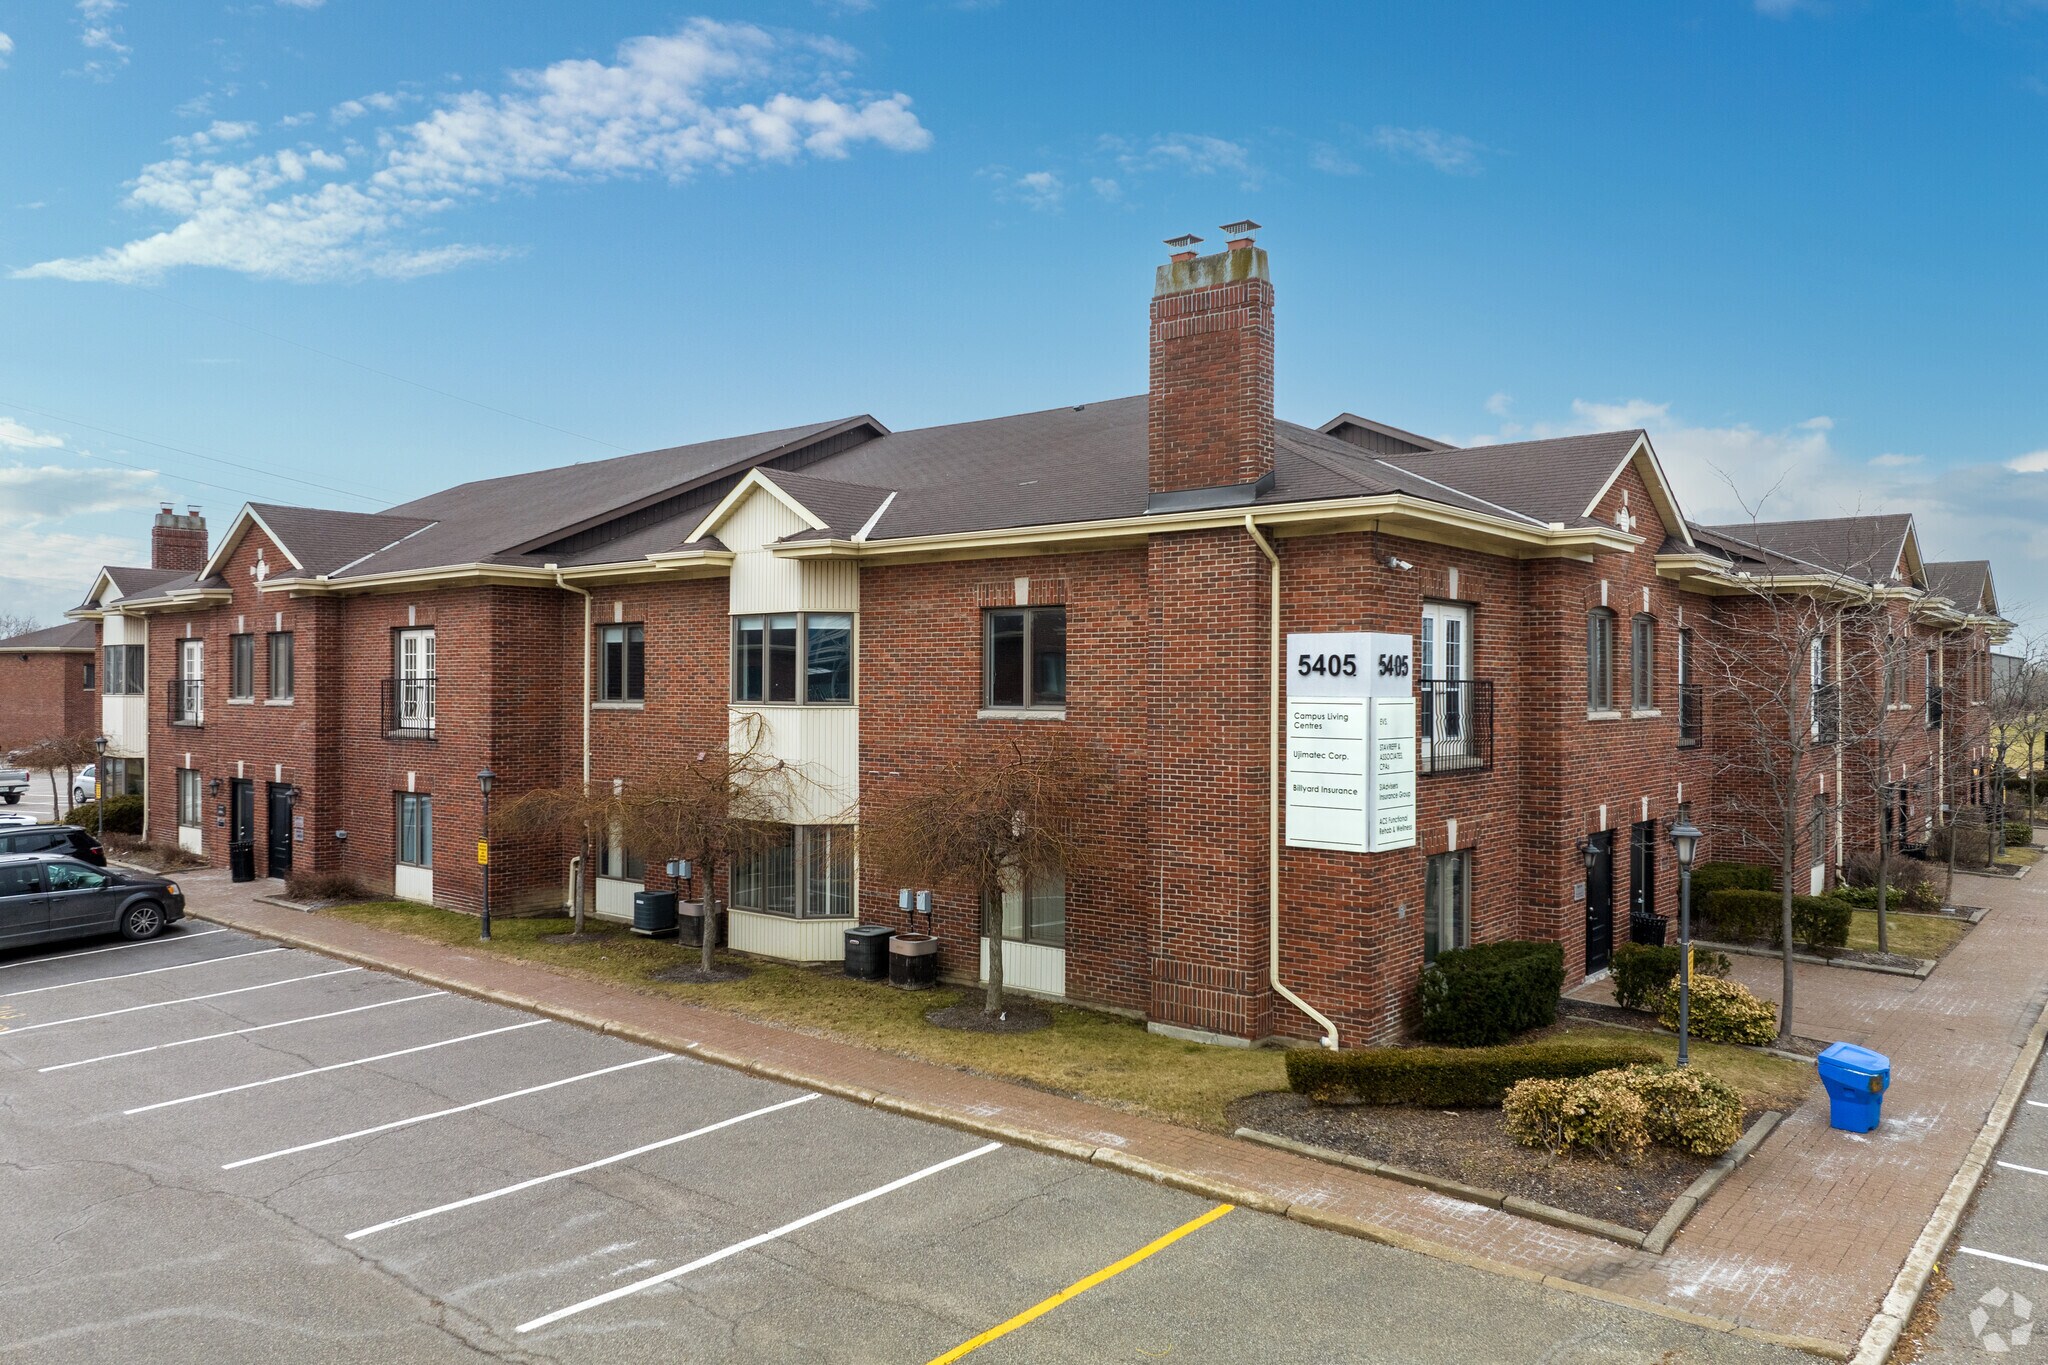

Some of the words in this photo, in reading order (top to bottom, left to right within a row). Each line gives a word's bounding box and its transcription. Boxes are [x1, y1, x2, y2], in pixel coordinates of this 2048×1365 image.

[1298, 654, 1356, 677] 5405
[1378, 653, 1409, 677] 5405
[1294, 712, 1325, 721] Campus
[1327, 712, 1349, 722] Living
[1294, 721, 1322, 730] Centres
[1293, 750, 1326, 760] Ujimatec
[1328, 752, 1349, 761] Corp.
[1292, 784, 1319, 794] Billyard
[1321, 785, 1358, 796] Insurance
[1379, 792, 1398, 800] Insurance
[1399, 791, 1411, 799] Group
[1388, 814, 1408, 824] Functional
[1379, 827, 1392, 835] Rehab
[1396, 823, 1413, 832] Wellness
